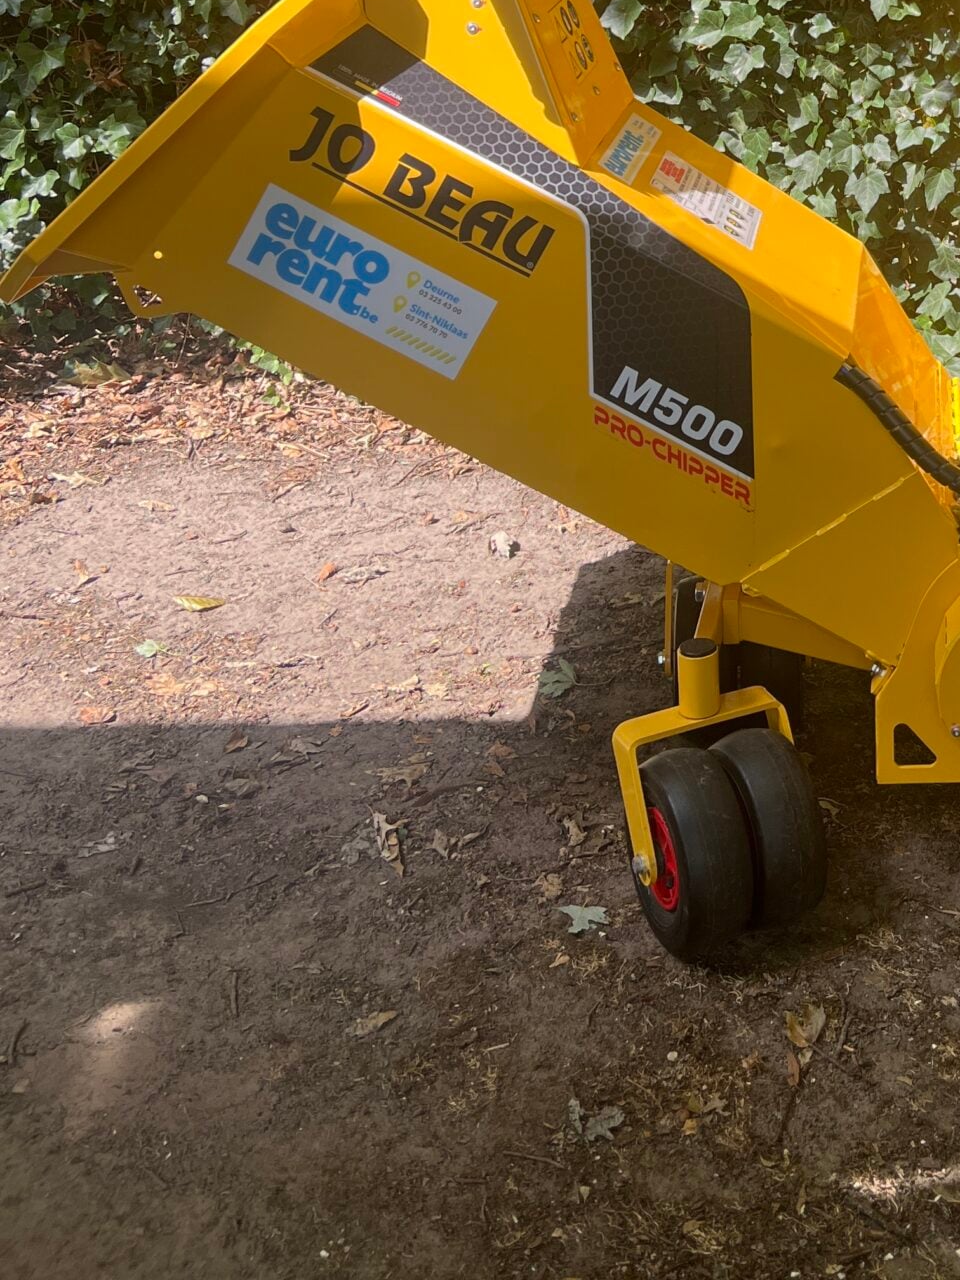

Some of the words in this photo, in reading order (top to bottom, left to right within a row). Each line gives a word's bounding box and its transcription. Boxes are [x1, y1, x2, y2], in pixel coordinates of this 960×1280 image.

[289, 106, 376, 175] JO
[383, 153, 556, 273] BEAU
[265, 202, 390, 285] euro
[405, 313, 414, 322] 03
[409, 304, 469, 339] Sint-Niklaas
[418, 289, 429, 298] 03
[452, 306, 463, 315] 00
[423, 280, 460, 304] Deurne
[609, 365, 744, 456] M500
[594, 406, 751, 505] PRO-CHIPPER
